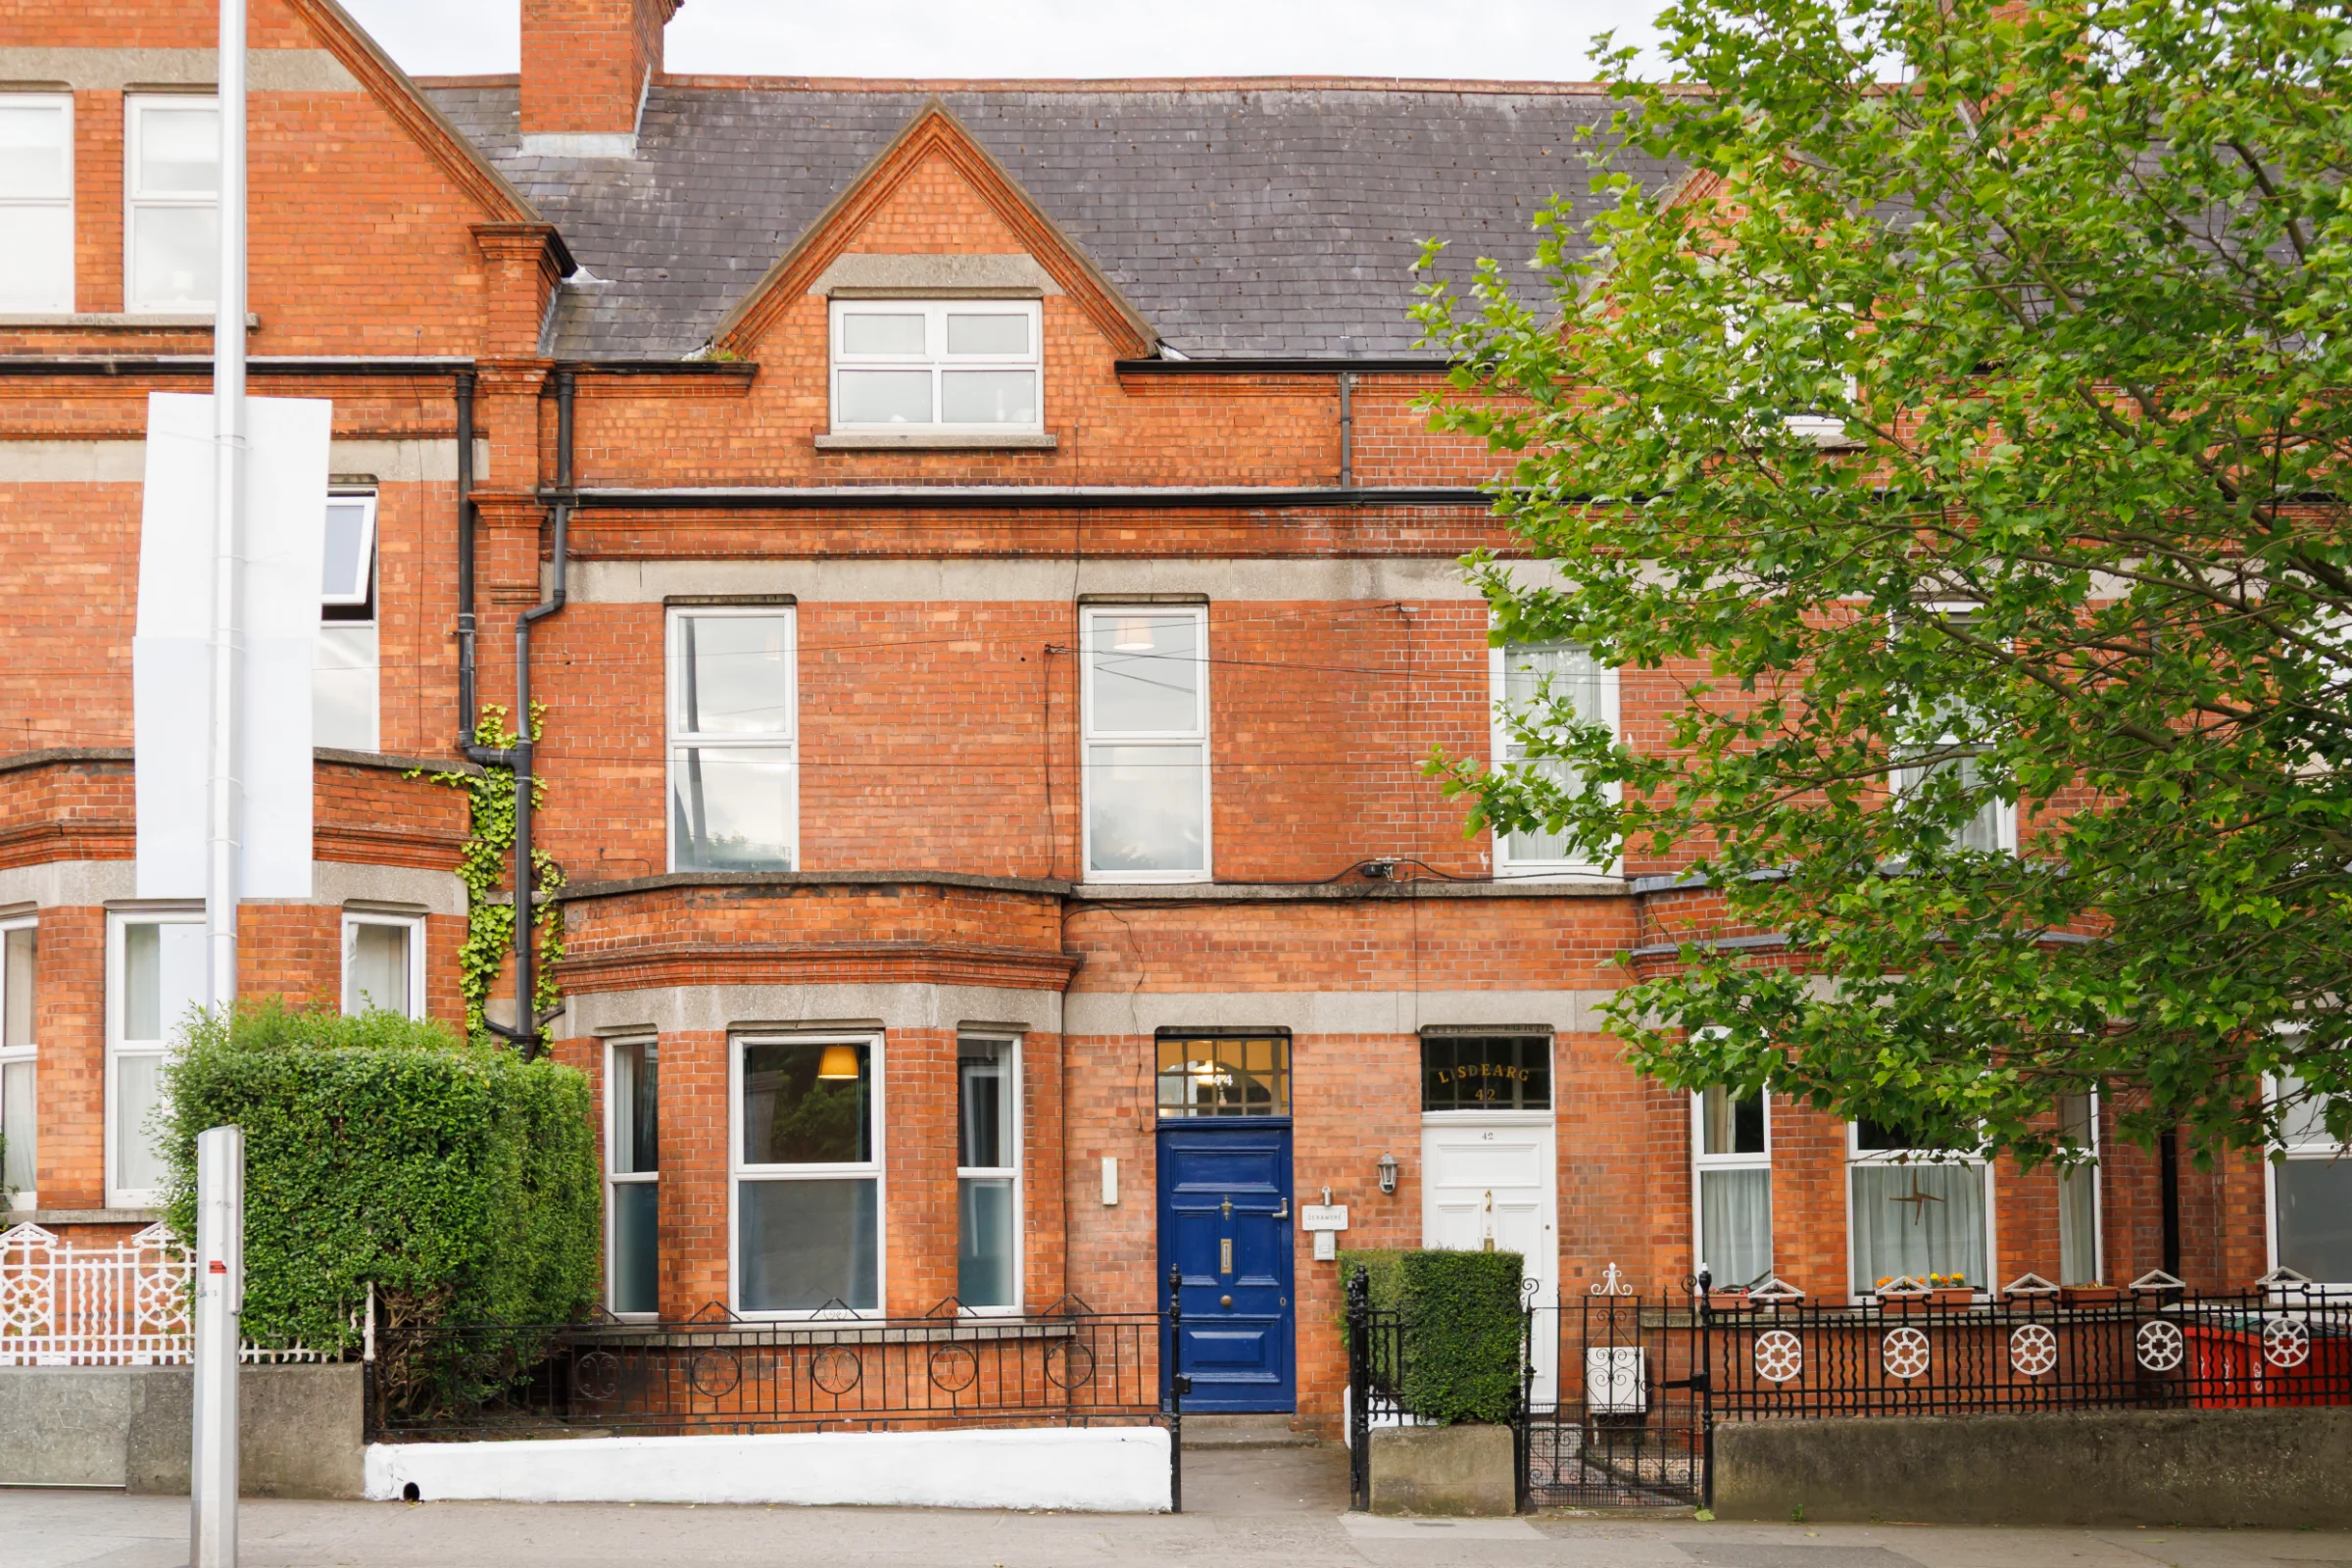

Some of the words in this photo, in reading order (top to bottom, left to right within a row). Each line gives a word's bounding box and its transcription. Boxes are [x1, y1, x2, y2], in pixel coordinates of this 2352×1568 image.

[1438, 1063, 1529, 1084] LISDEARG
[1213, 1074, 1233, 1087] 44
[1475, 1089, 1495, 1101] 42
